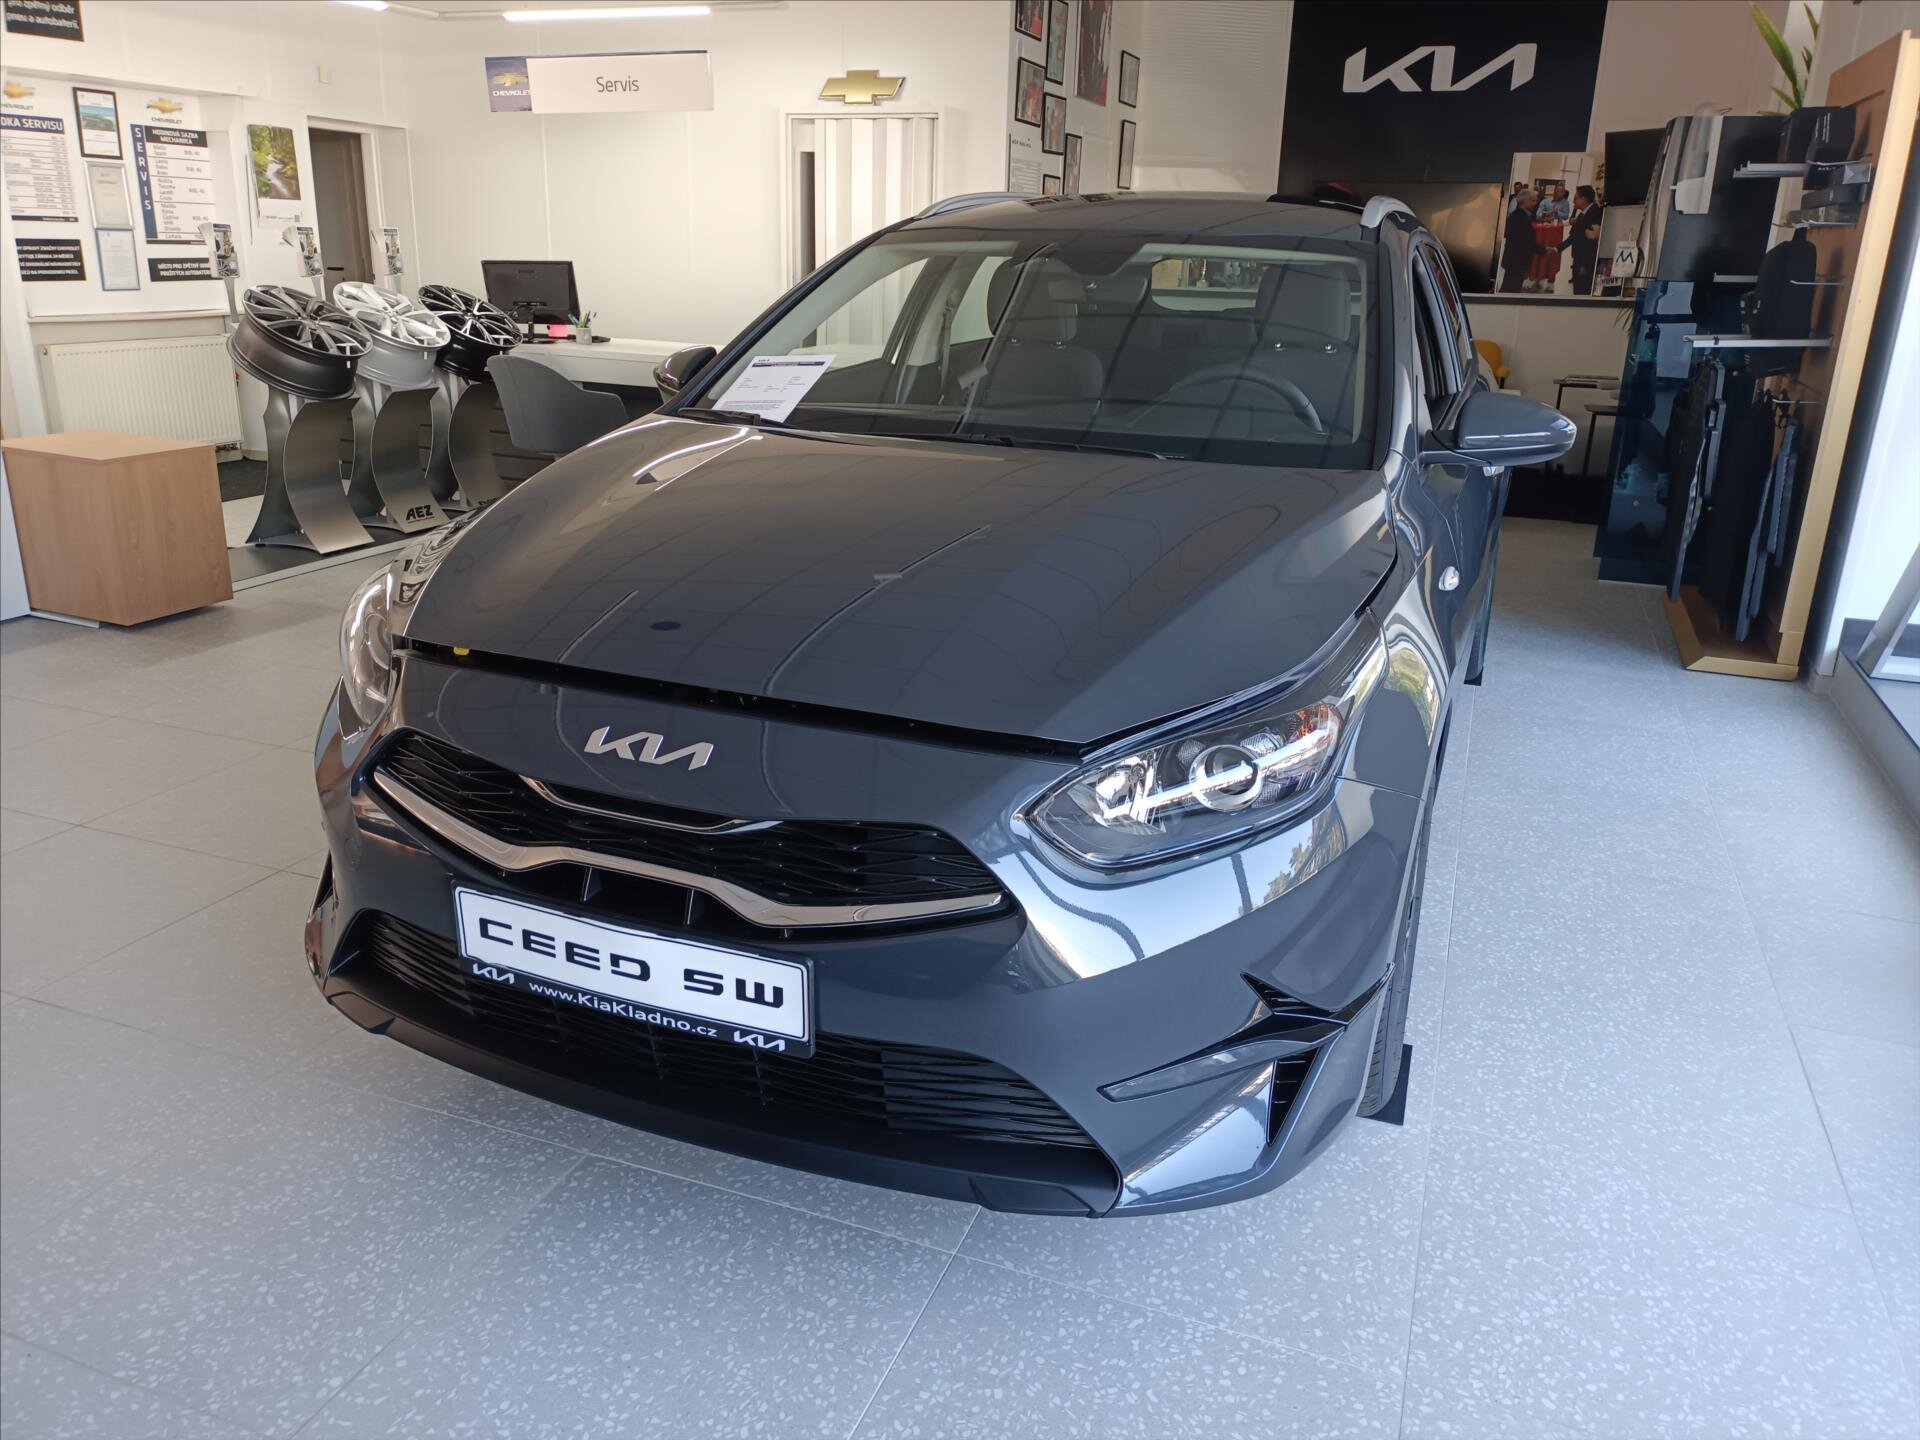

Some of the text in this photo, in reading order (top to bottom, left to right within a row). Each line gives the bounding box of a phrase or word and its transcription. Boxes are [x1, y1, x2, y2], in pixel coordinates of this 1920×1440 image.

[595, 75, 640, 93] Servis
[1342, 42, 1538, 93] KIA
[22, 118, 63, 131] SERVISU
[405, 504, 434, 521] AEZ
[584, 726, 714, 771] KIA
[479, 916, 785, 1009] CEED SW
[472, 963, 786, 1052] KIA www.KiaKladno.cz KIA
